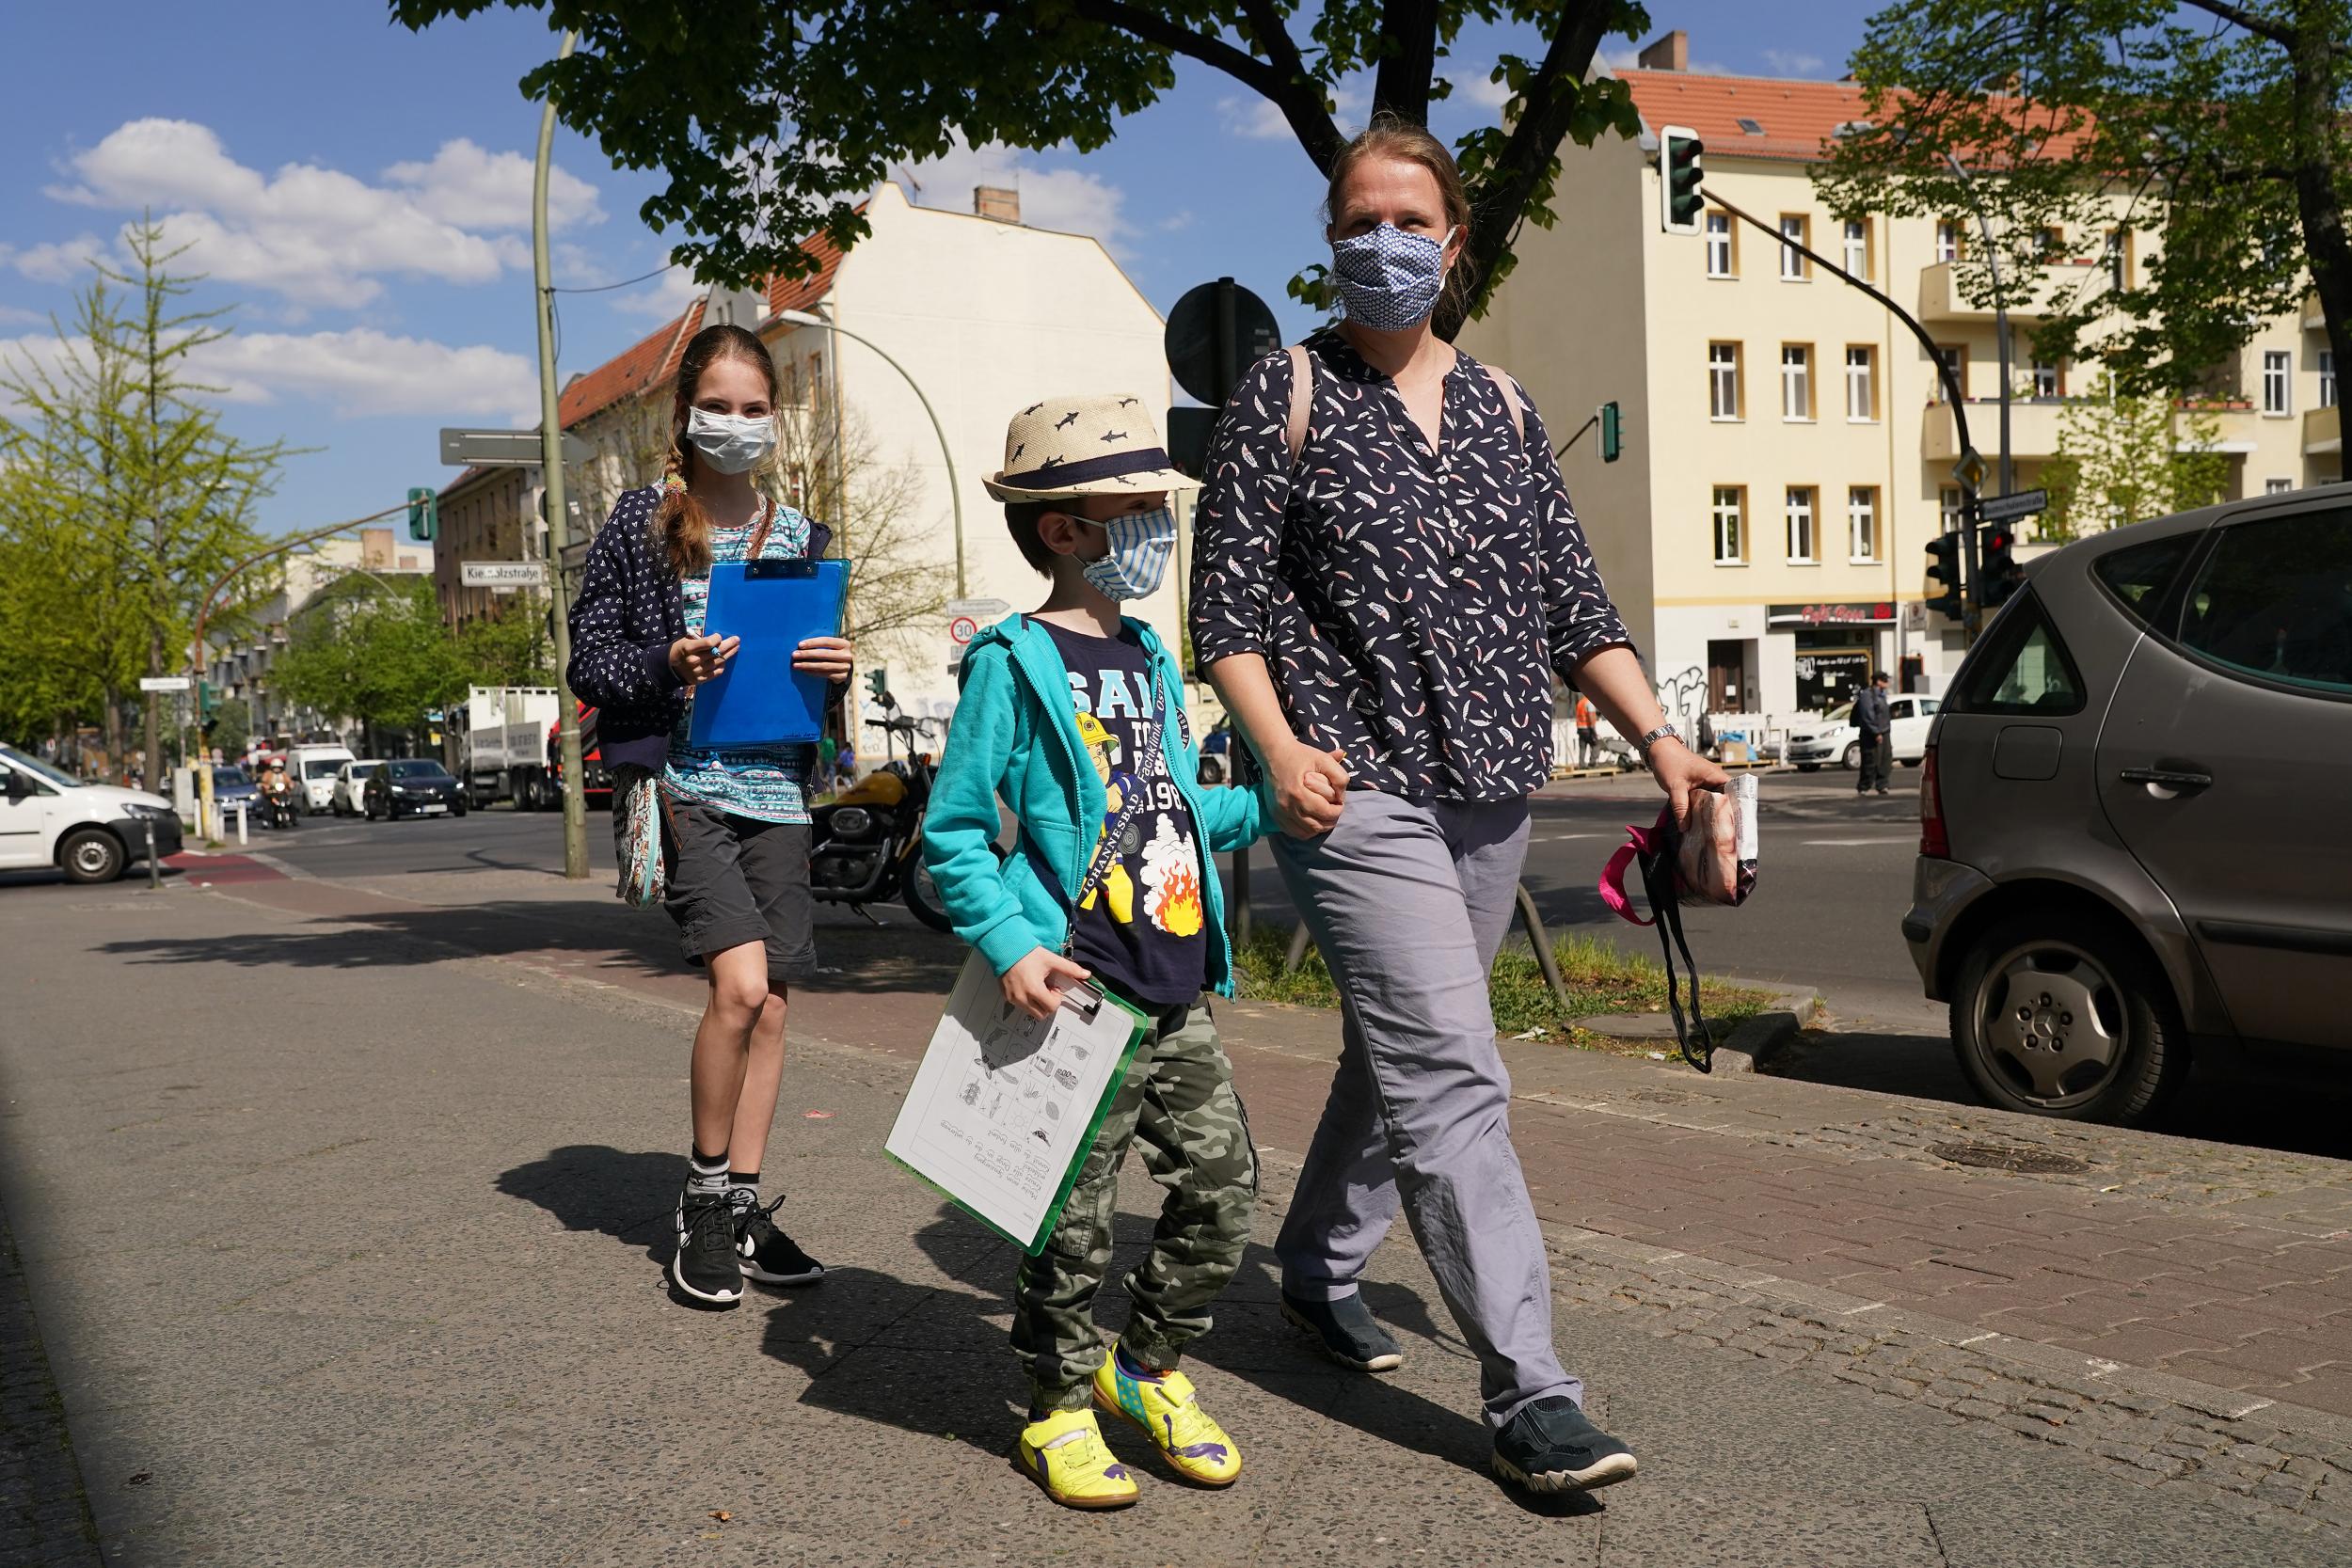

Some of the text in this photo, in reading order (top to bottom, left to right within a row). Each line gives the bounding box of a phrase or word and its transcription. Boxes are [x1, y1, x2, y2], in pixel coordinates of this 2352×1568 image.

[956, 625, 972, 637] 30
[1083, 793, 1139, 895] JOHANNESBAD
[1137, 721, 1163, 784] Fachklinik
